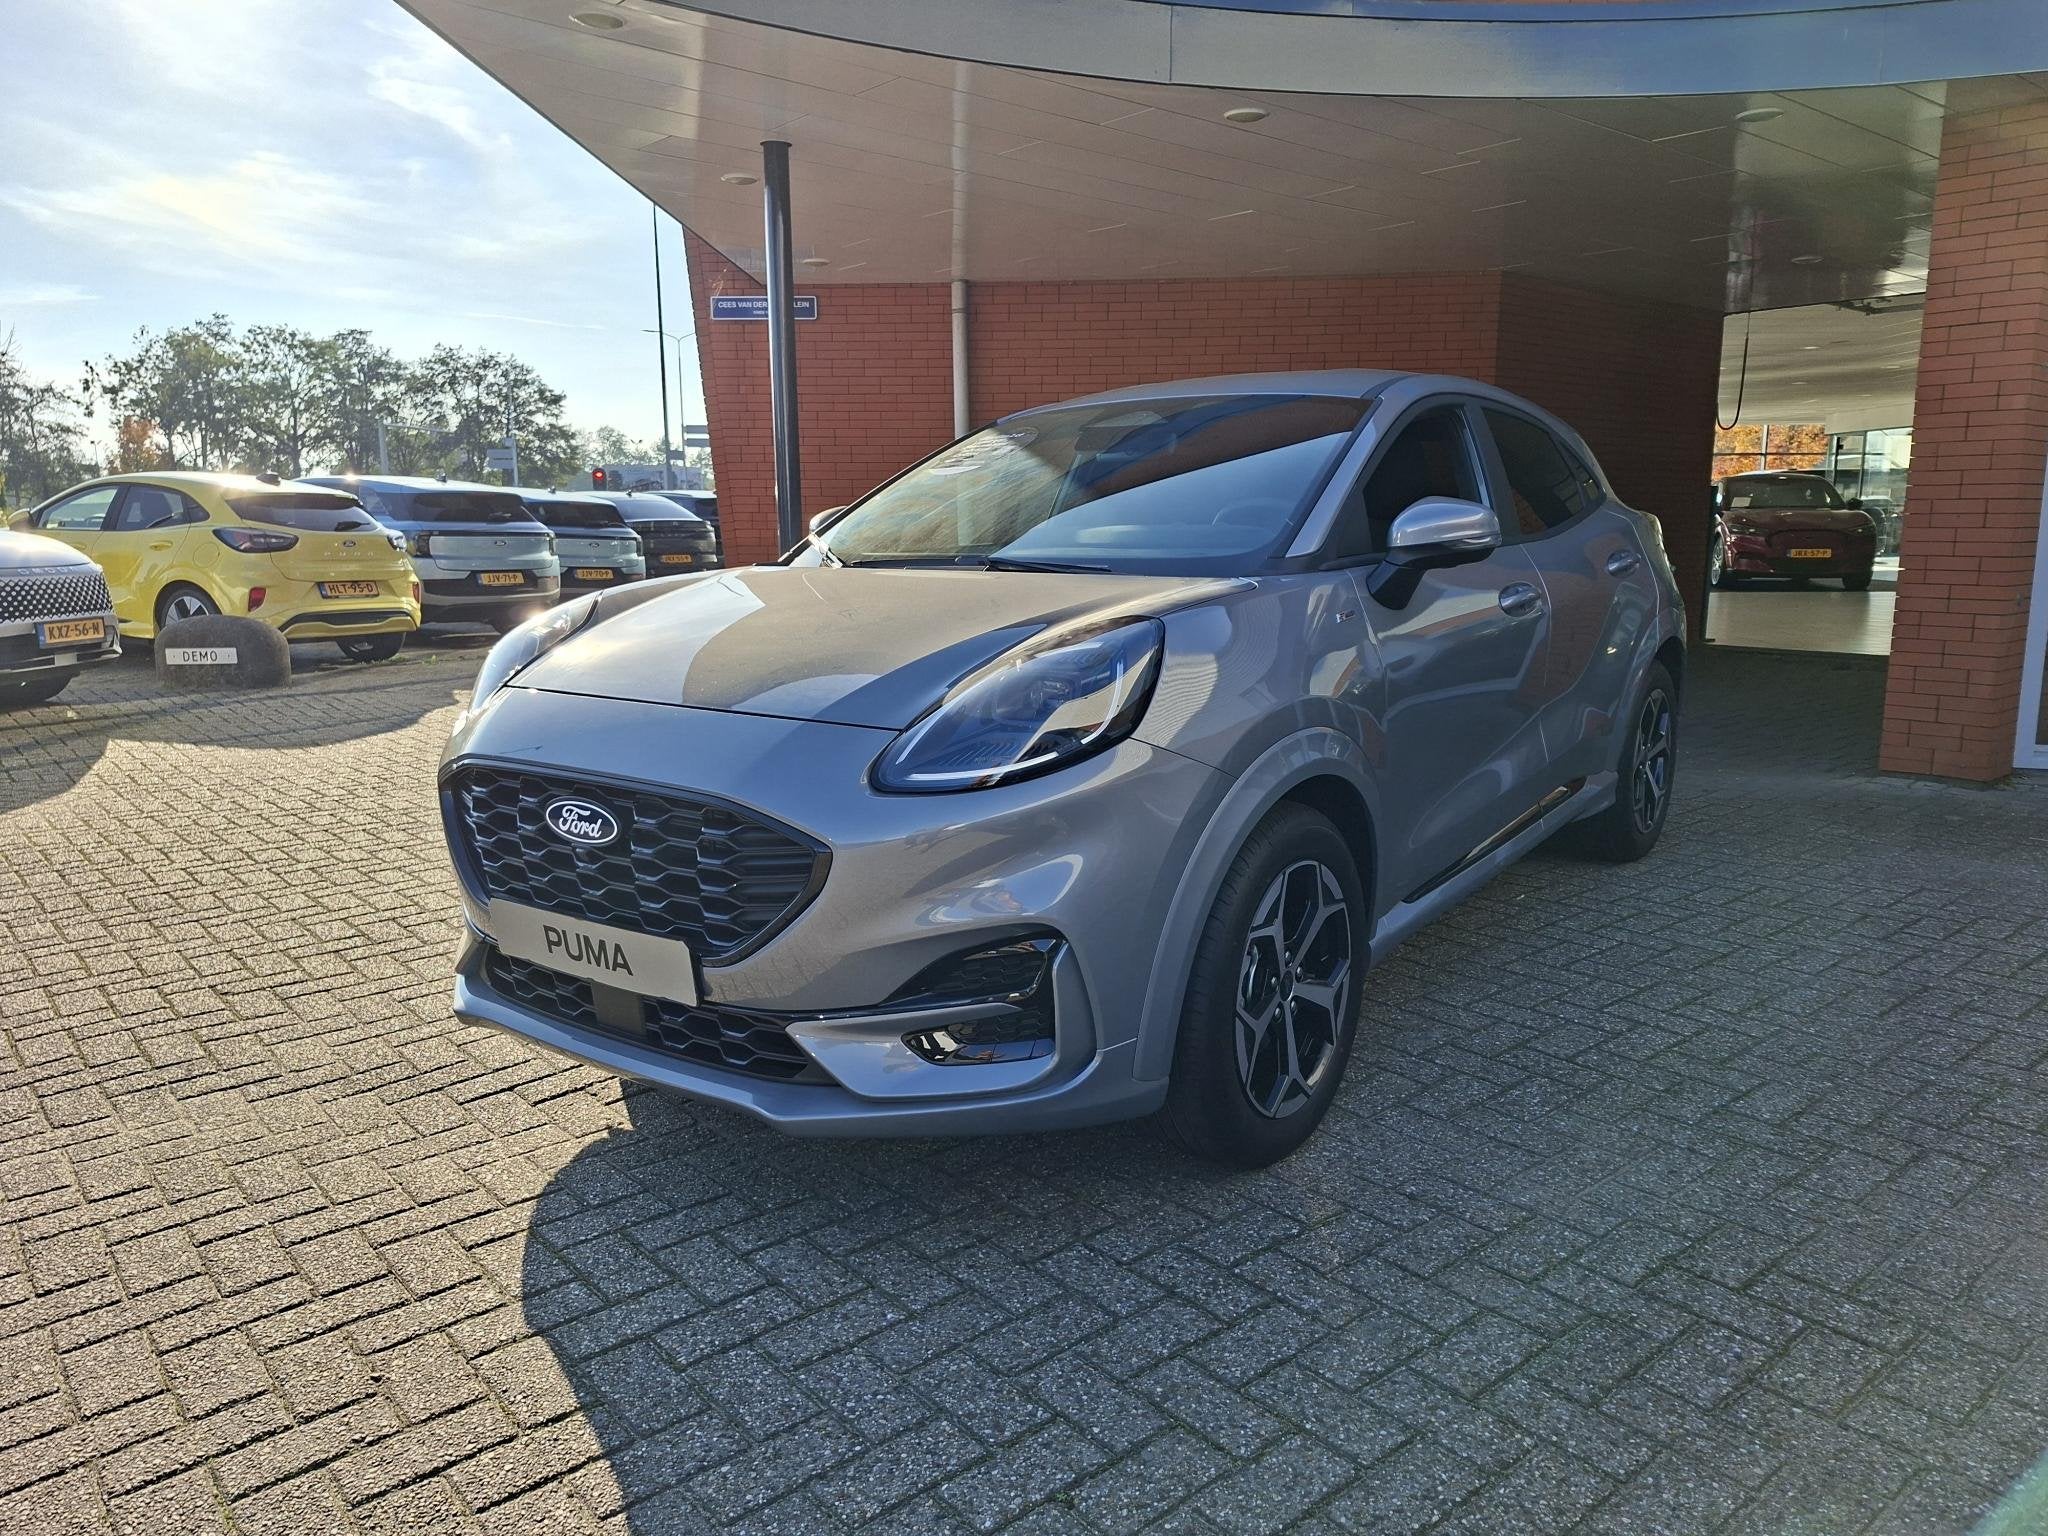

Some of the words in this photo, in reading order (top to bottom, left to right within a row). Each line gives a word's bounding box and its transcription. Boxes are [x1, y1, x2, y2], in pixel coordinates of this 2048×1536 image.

[487, 573, 518, 583] JJV-71-P
[327, 582, 374, 594] HLT-95-D
[48, 621, 101, 641] KXZ-56-N
[182, 650, 218, 662] DEMO
[558, 805, 603, 839] Ford
[542, 923, 634, 977] PUMA
